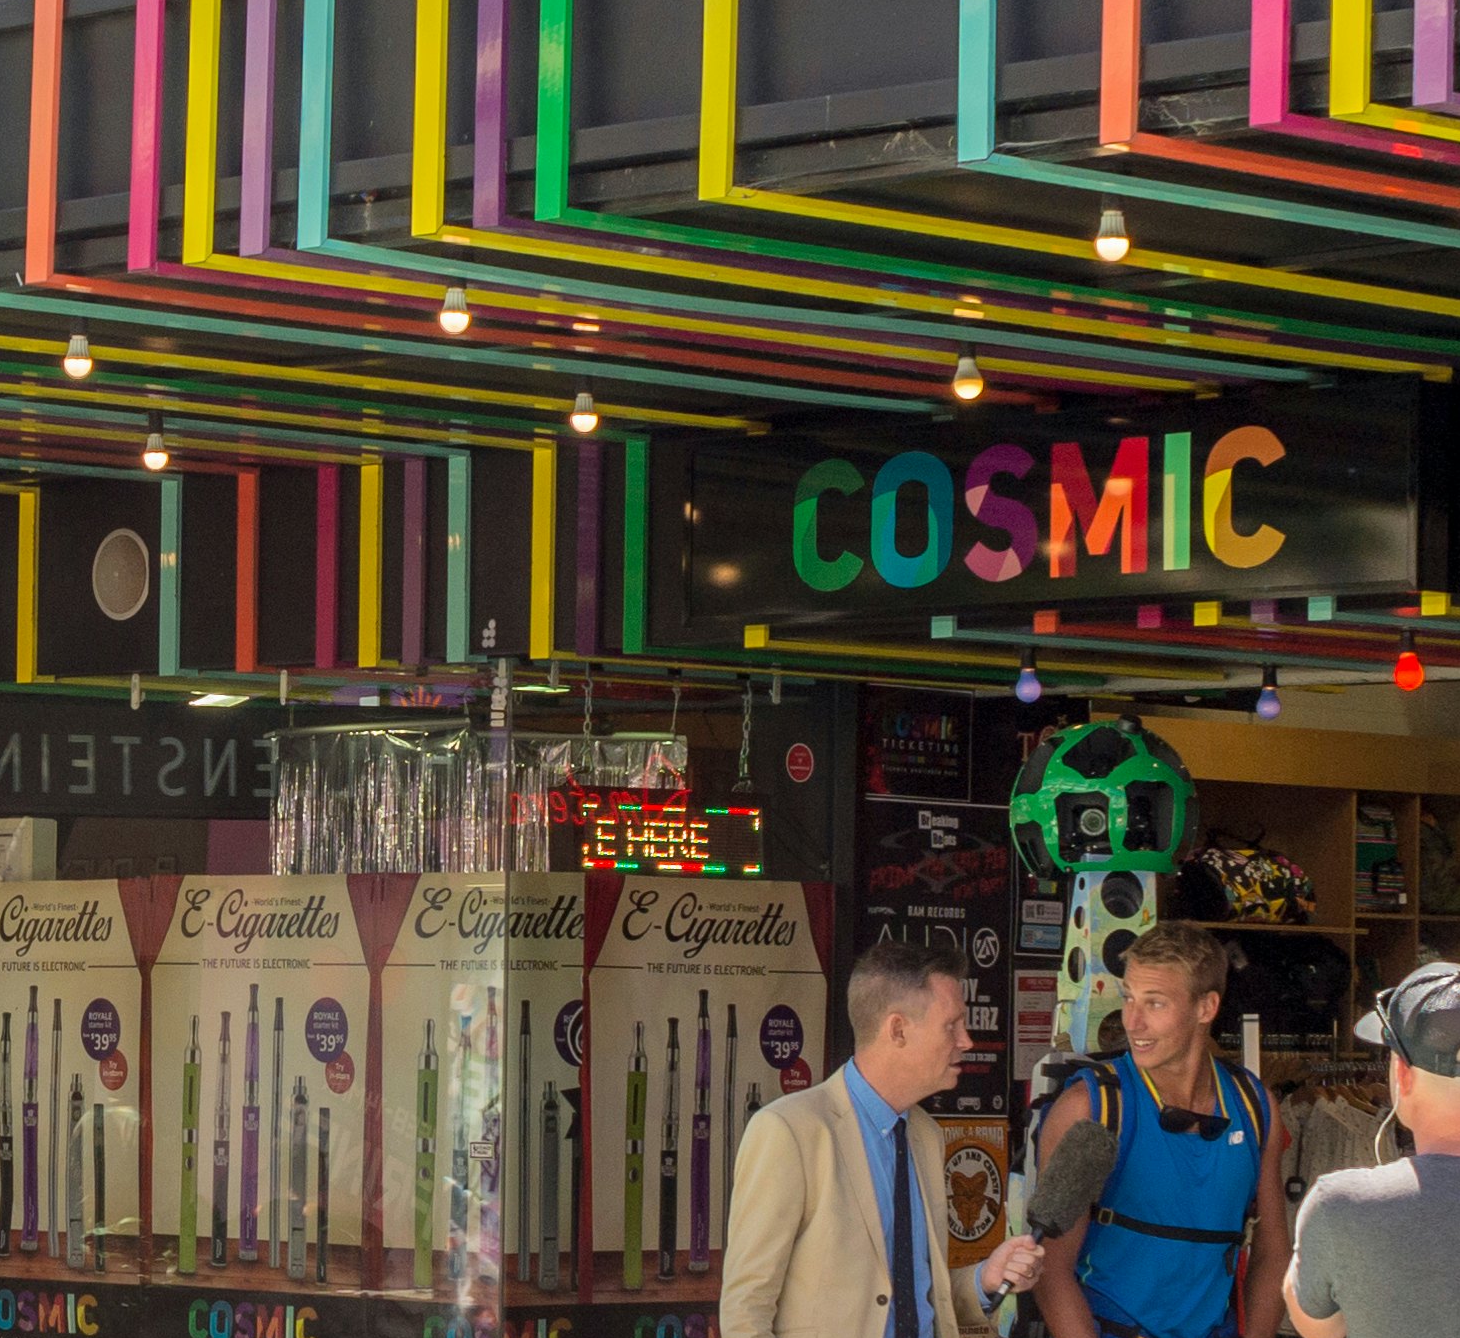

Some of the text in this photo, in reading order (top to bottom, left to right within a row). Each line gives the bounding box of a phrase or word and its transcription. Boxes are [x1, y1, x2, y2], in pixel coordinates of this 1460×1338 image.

[792, 425, 1287, 593] COSMIC
[627, 821, 710, 859] HERE
[928, 906, 966, 919] RECORDS
[180, 888, 340, 953] E-Cigarettes
[622, 889, 797, 958] E-Cigarettes
[1, 960, 31, 972] FUTURE
[32, 961, 40, 972] IS
[41, 961, 86, 972] ELECTRONIC
[202, 958, 311, 970] THE FUTURE IS ELECTRONIC
[439, 959, 559, 971] THE FUTURE IS ELECTRONIC
[646, 962, 767, 977] THE FUTURE IS ELECTRONIC
